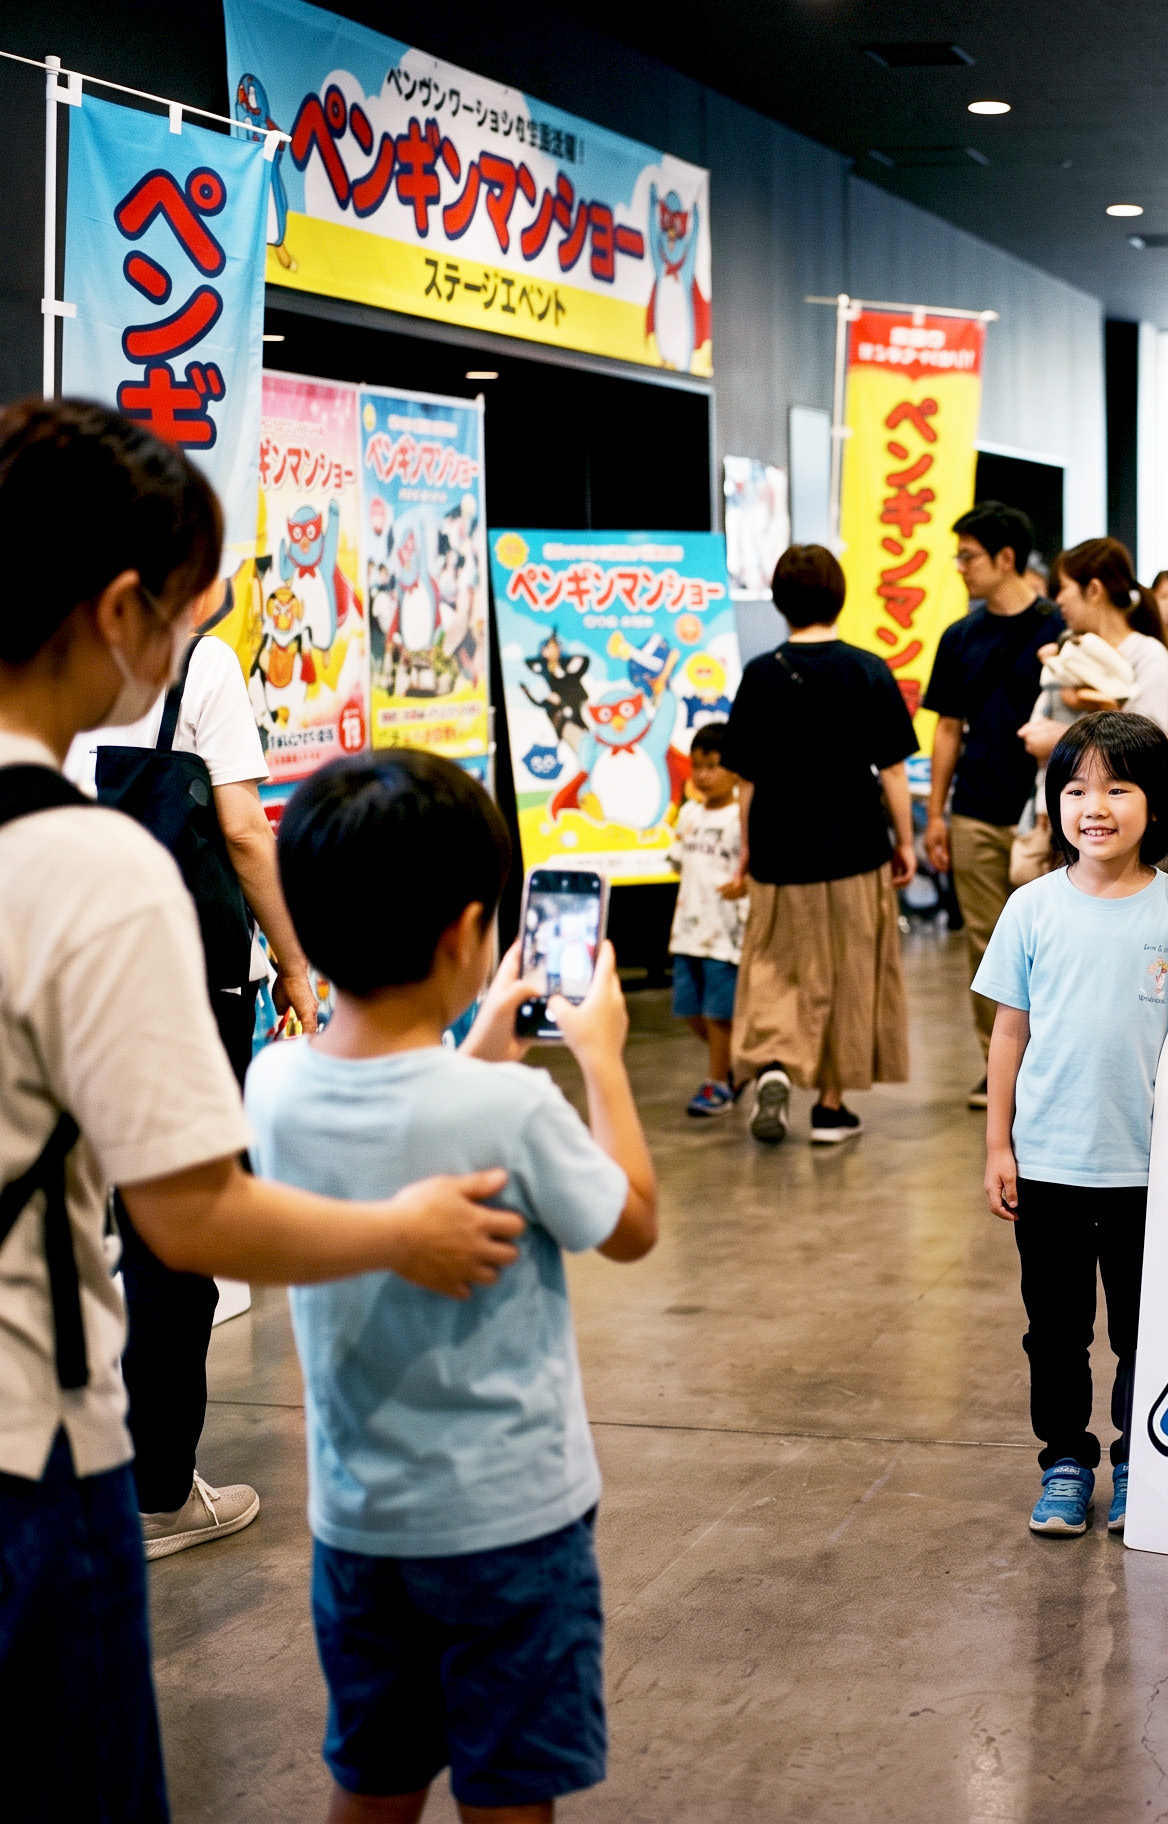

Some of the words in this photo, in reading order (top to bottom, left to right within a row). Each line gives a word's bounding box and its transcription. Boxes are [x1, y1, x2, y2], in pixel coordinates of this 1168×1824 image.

[289, 84, 645, 284] ペンギンマンショー
[507, 563, 724, 613] ペンギンマンショー
